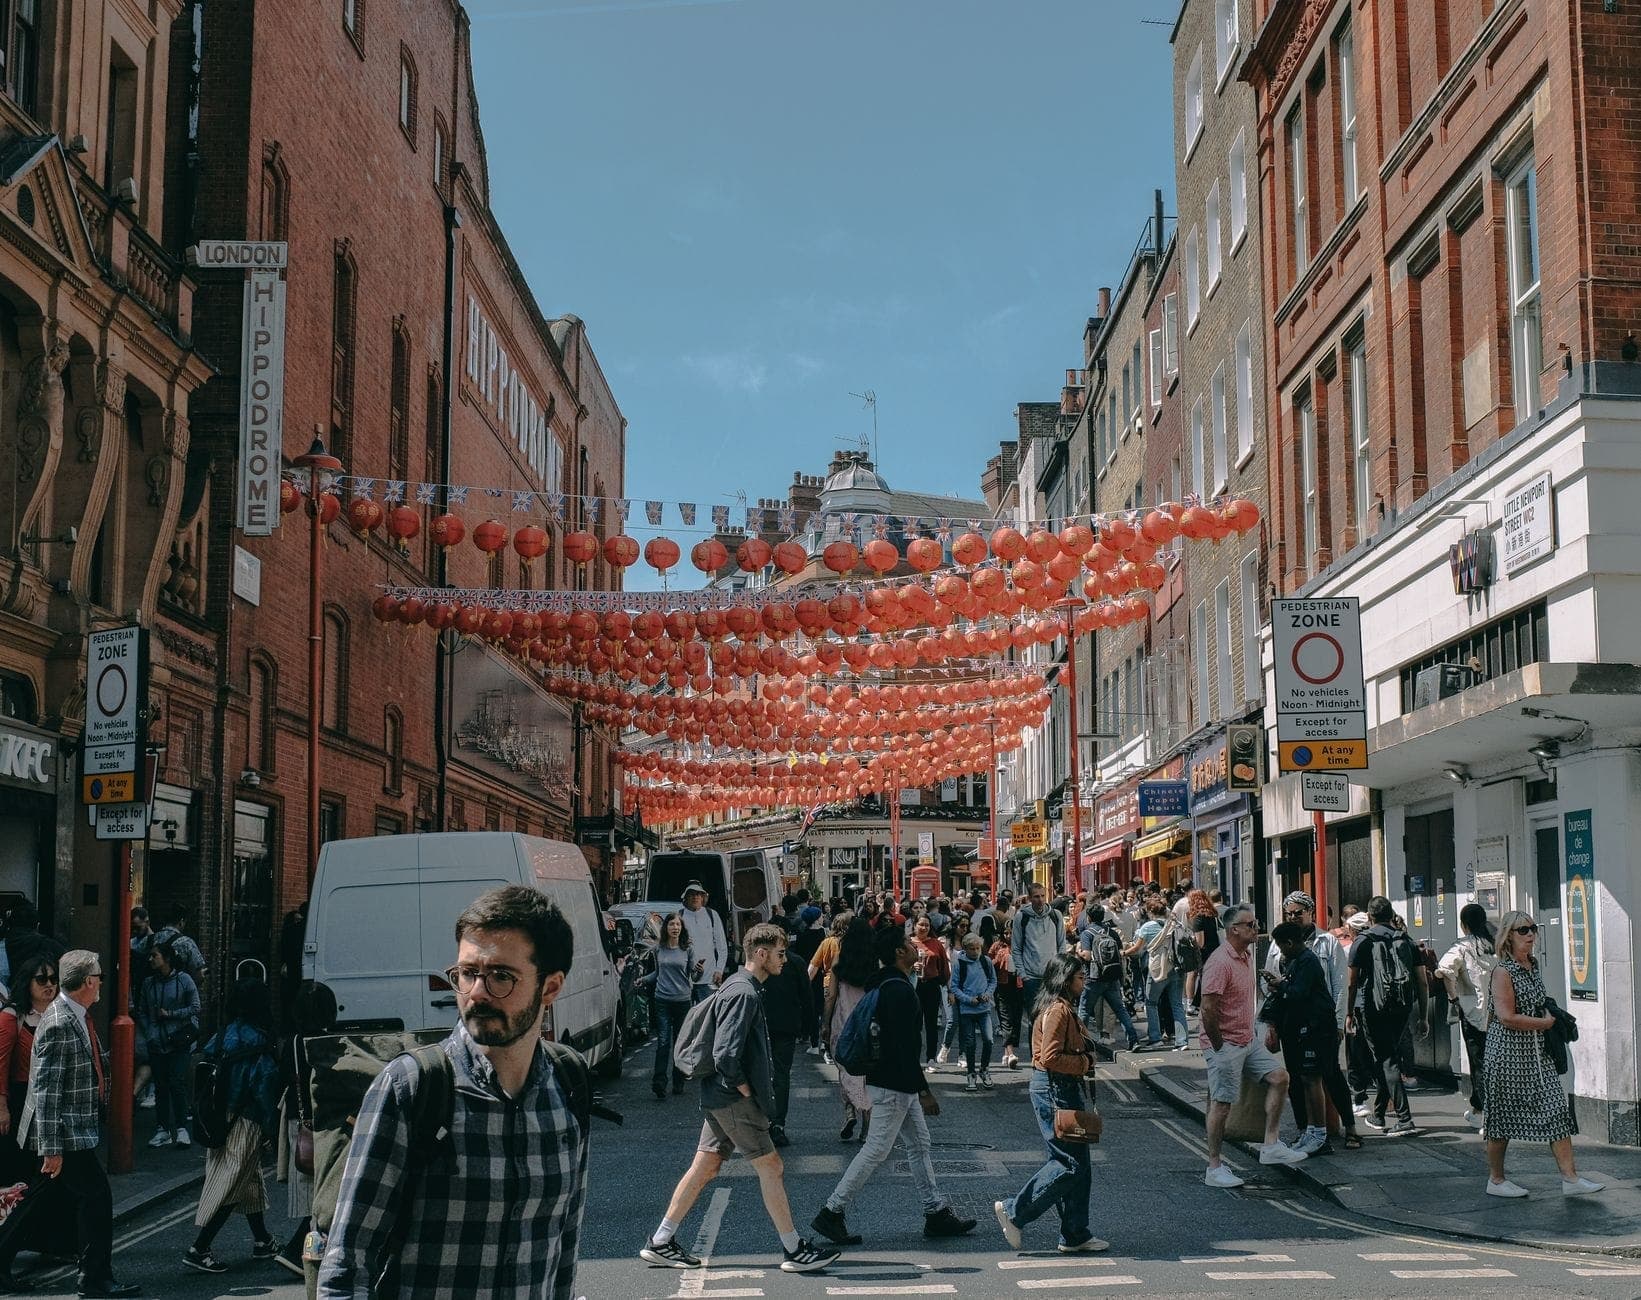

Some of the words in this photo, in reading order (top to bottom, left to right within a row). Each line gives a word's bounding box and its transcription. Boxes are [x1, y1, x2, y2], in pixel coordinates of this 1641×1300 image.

[205, 245, 281, 264] LONDON
[247, 281, 274, 526] HIPPODROME
[1504, 497, 1519, 518] LITTLE
[1520, 481, 1545, 508] NEWPORT
[1505, 514, 1522, 536] STREET
[1523, 507, 1534, 525] WC2
[1281, 602, 1350, 612] PEDESTRIAN
[1291, 614, 1341, 628] ZONE
[93, 631, 134, 644] PEDESTRIAN
[98, 644, 128, 661] ZONE
[1291, 688, 1306, 698] No
[1309, 687, 1349, 697] vehicles
[1281, 700, 1307, 710] Noon
[1316, 699, 1360, 711] Midnight
[93, 722, 103, 731] No
[104, 719, 129, 730] vehicles
[1295, 717, 1331, 729] Except
[1333, 716, 1348, 726] for
[87, 733, 104, 743] Noon
[107, 729, 135, 742] Midnight
[1305, 729, 1339, 737] access
[3, 733, 52, 783] KFC
[94, 751, 115, 763] Except
[116, 749, 126, 760] for
[1321, 746, 1334, 755] At
[1336, 747, 1354, 757] any
[99, 760, 120, 770] access
[1327, 756, 1350, 765] time
[107, 778, 115, 788] At
[115, 779, 128, 790] any
[1306, 777, 1332, 793] Except
[1333, 780, 1345, 791] for
[110, 789, 124, 798] time
[1313, 794, 1339, 805] access
[100, 807, 128, 823] Except
[129, 805, 142, 818] for
[106, 822, 135, 834] access
[1567, 818, 1589, 832] bureau
[1574, 836, 1583, 849] de
[832, 848, 856, 865] KU
[1568, 852, 1591, 868] change
